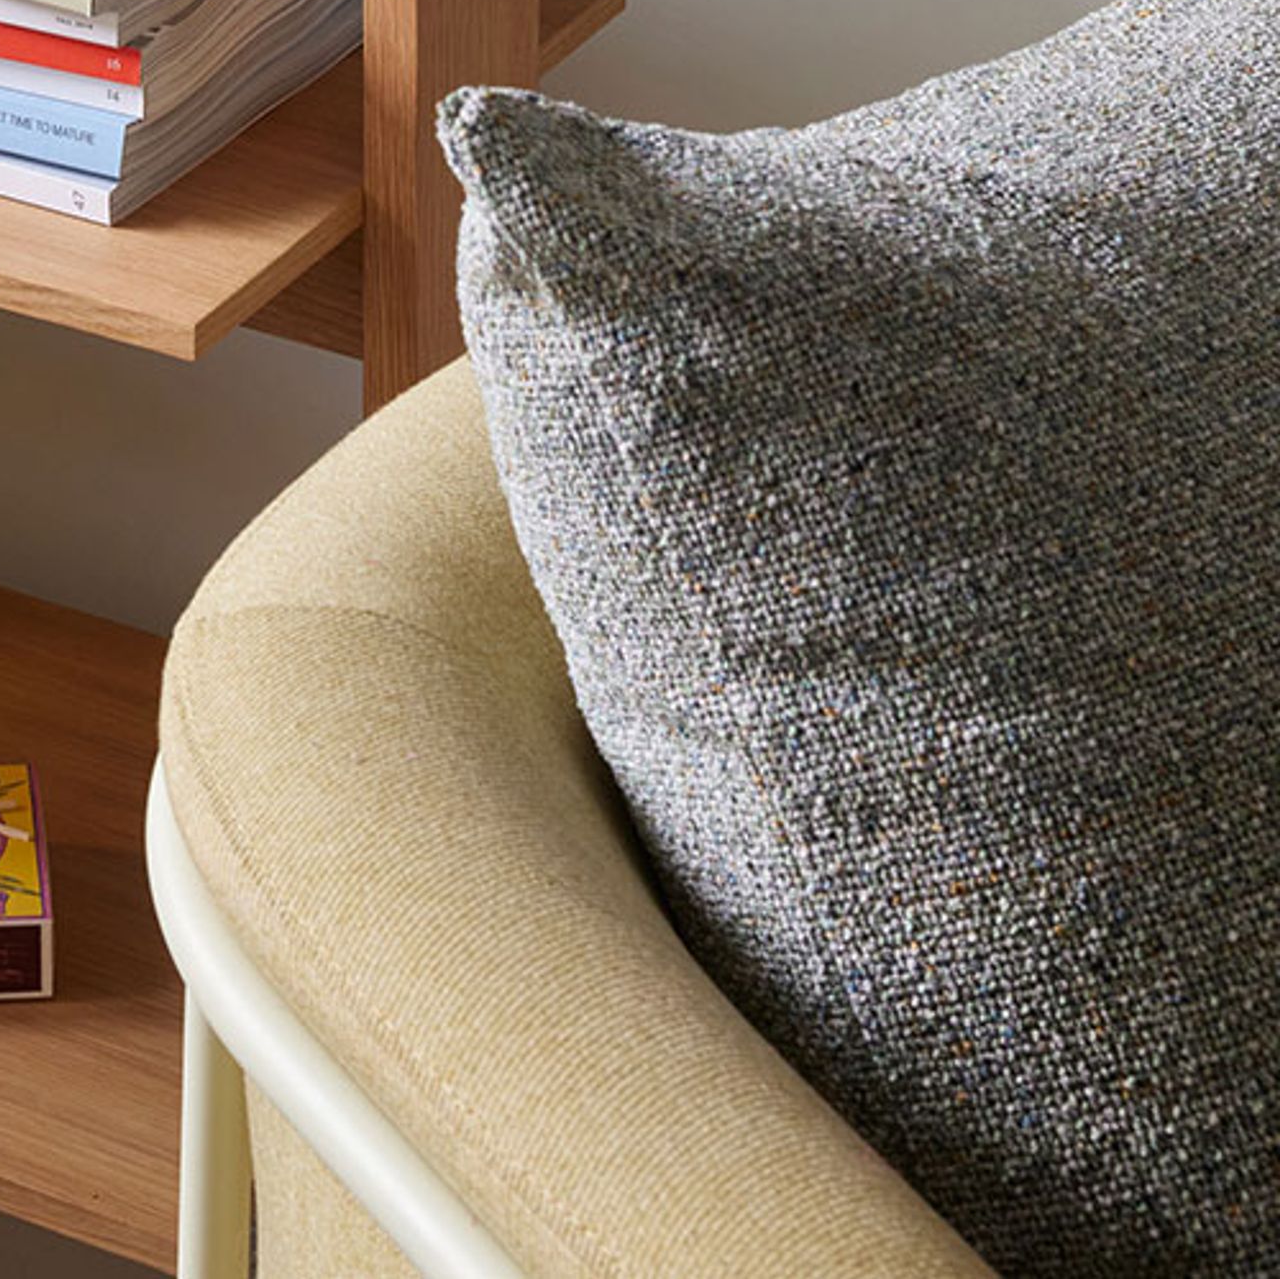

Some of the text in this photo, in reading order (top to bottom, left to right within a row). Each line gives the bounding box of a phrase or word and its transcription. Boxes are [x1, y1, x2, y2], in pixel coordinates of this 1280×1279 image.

[107, 88, 120, 103] 14
[9, 112, 31, 129] TIME
[35, 118, 49, 134] TO
[51, 122, 95, 145] MATURE
